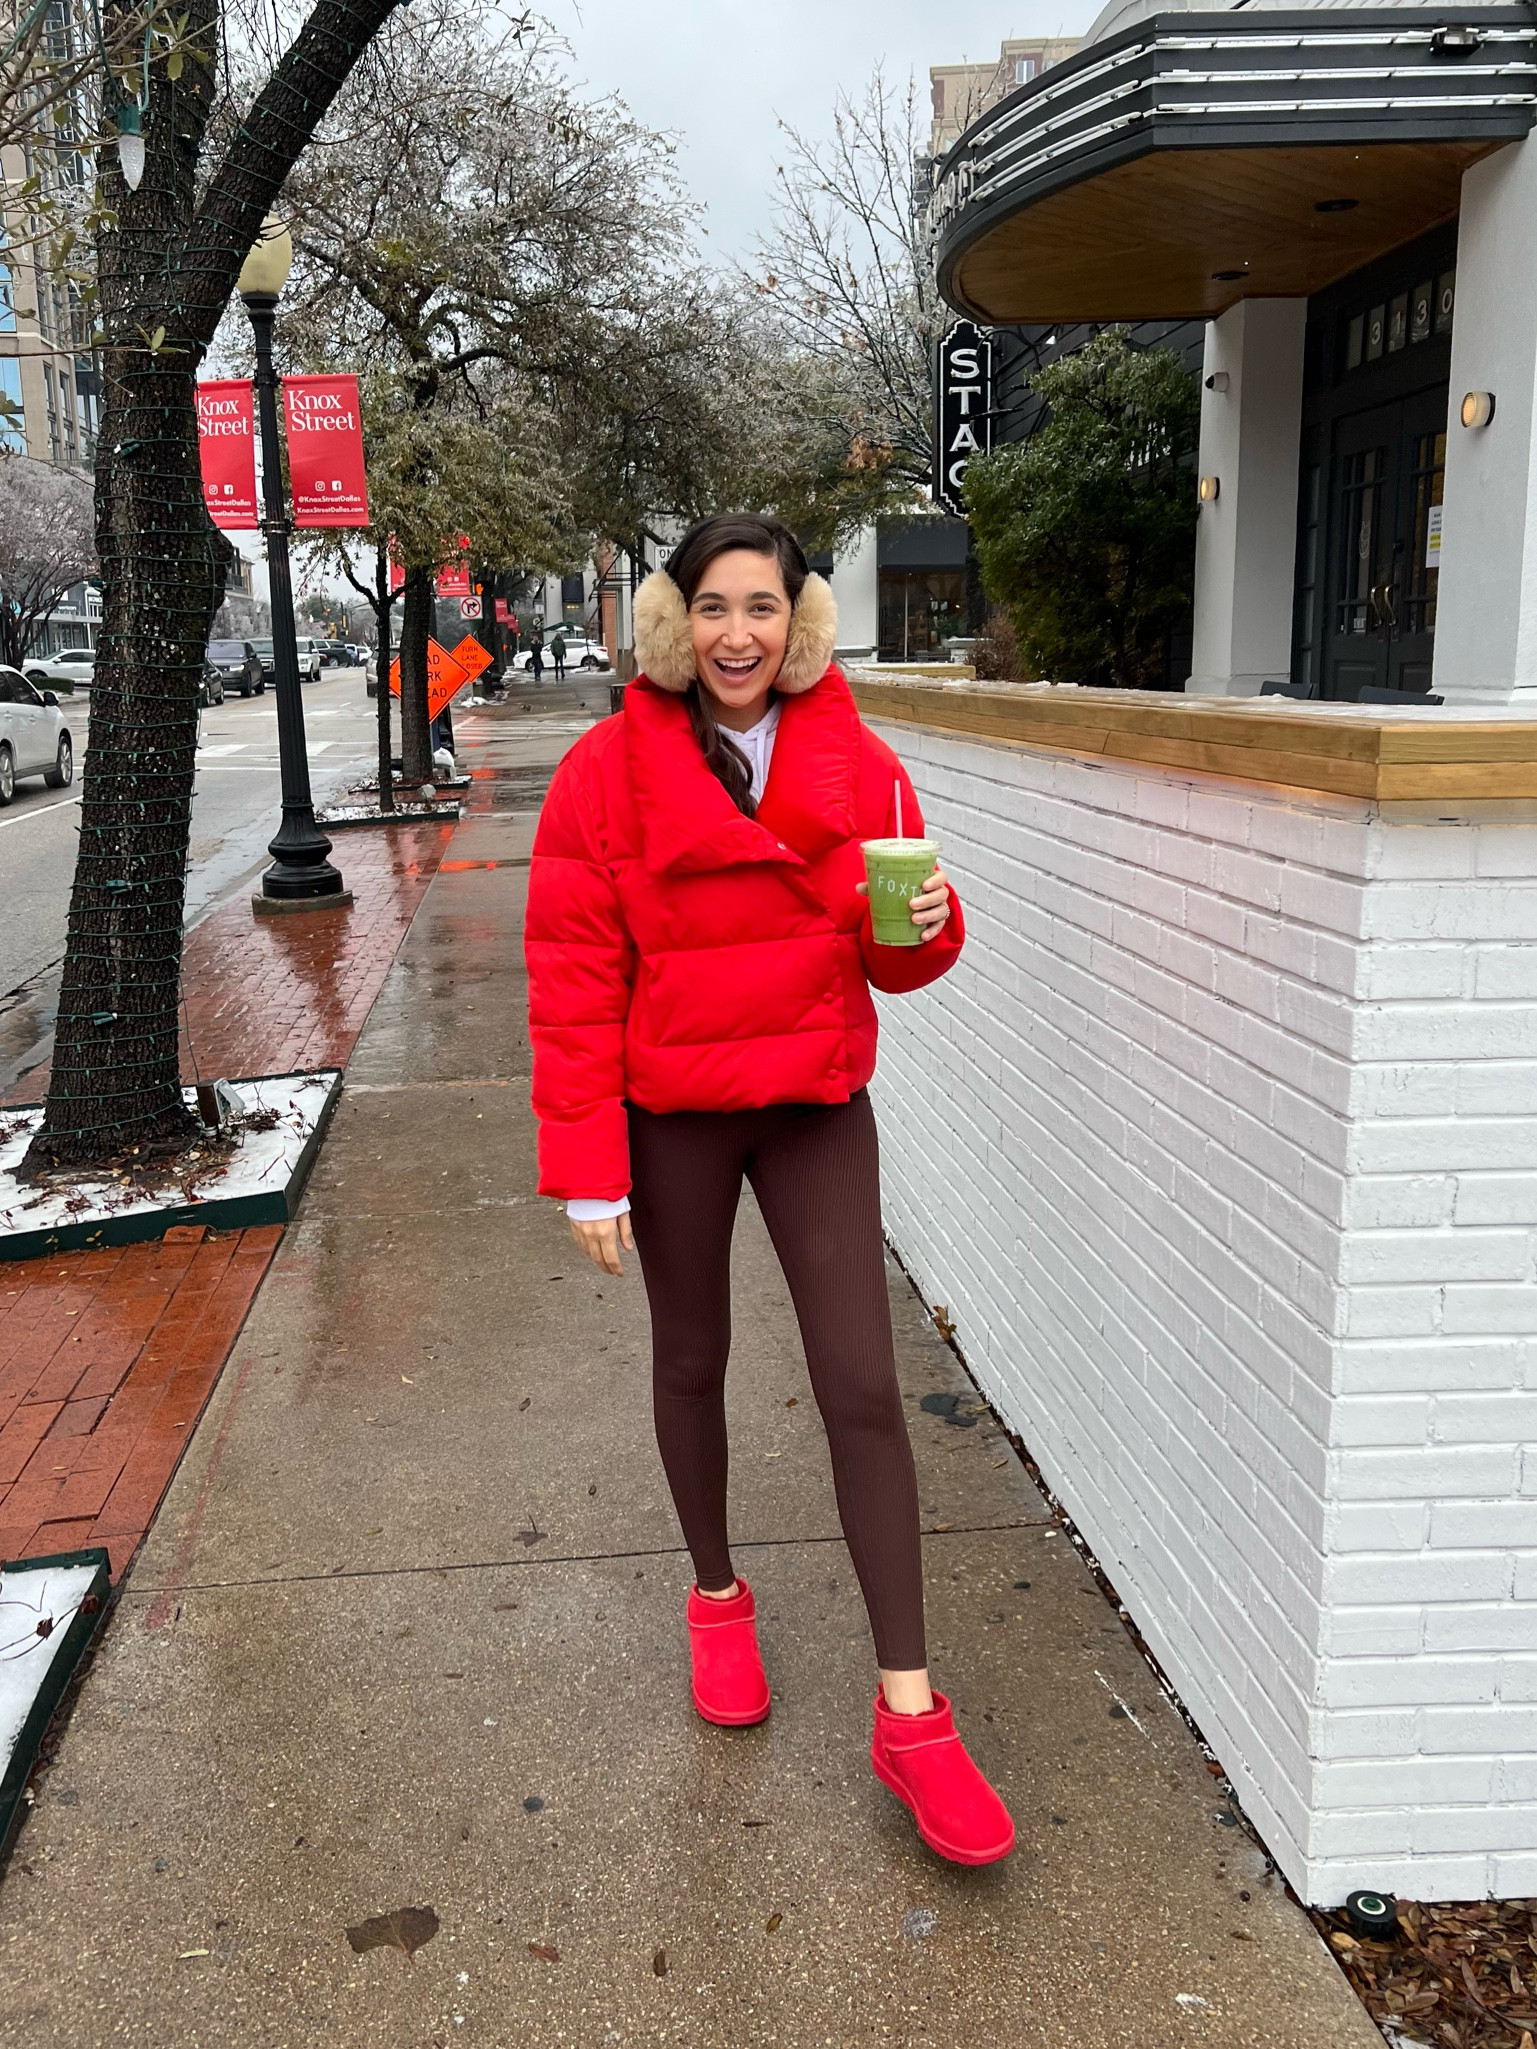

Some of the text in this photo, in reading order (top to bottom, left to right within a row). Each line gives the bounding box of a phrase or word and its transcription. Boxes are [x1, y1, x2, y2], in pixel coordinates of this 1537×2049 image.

[1371, 287, 1453, 345] 3130
[198, 396, 240, 417] Knox
[288, 389, 343, 412] Knox
[198, 416, 250, 438] Street
[291, 410, 357, 432] Street
[298, 495, 361, 503] @KnoxStreetDallas
[427, 671, 442, 681] RK
